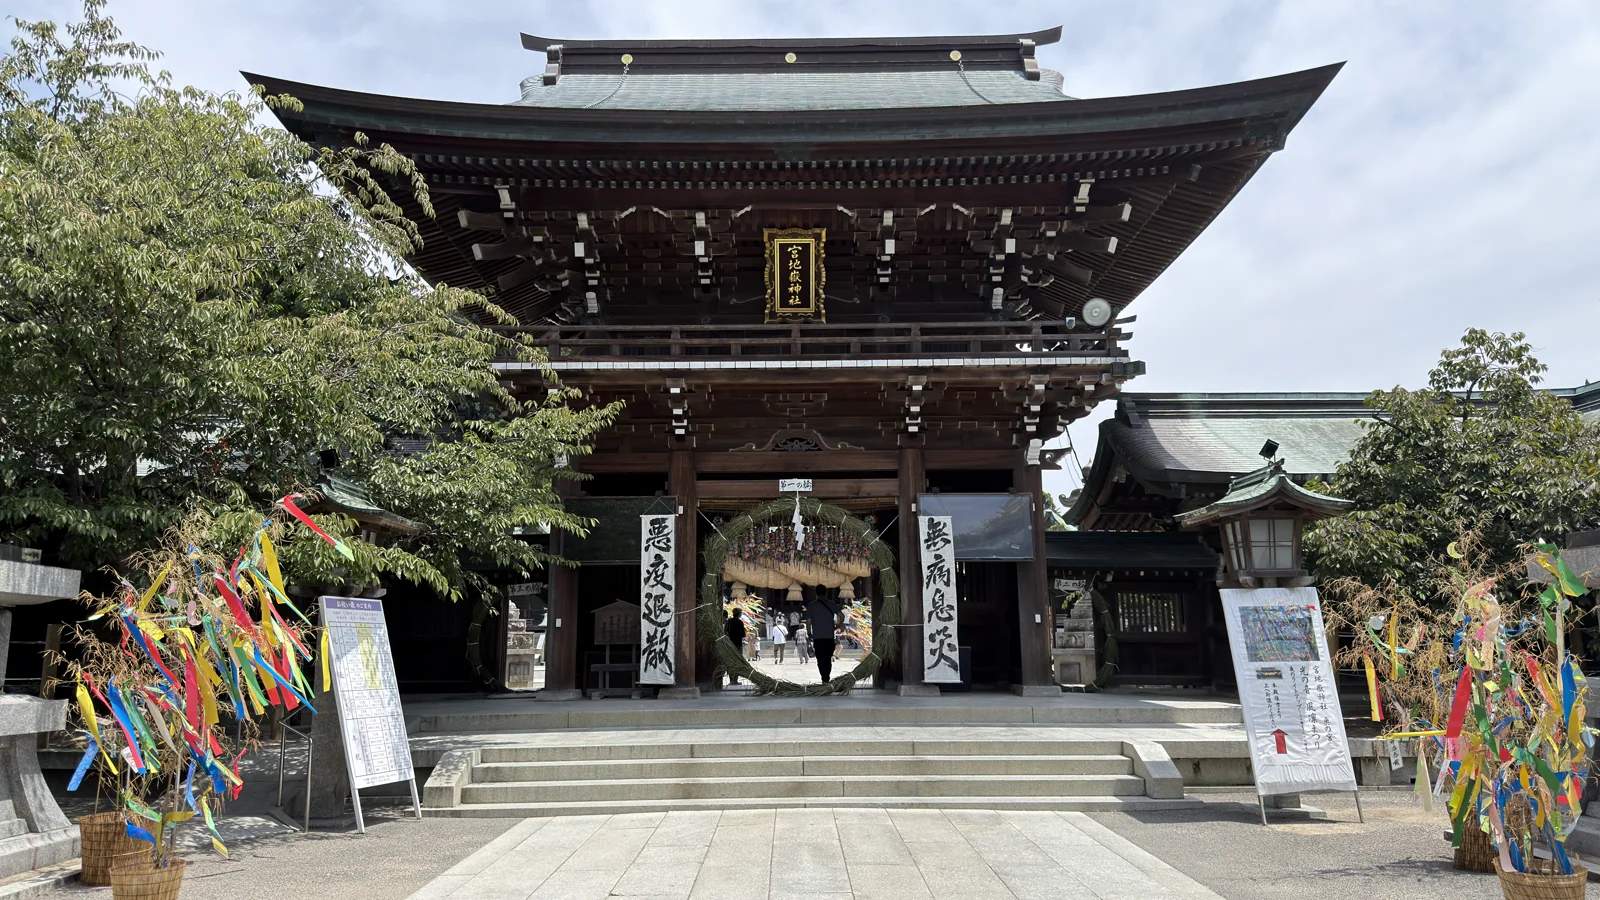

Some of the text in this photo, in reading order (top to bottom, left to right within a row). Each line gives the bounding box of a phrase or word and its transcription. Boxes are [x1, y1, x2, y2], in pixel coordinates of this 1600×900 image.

[787, 245, 803, 306] 宮地嶽神社
[642, 517, 673, 676] 悪疫退散
[923, 517, 959, 673] 無病息災
[1300, 666, 1311, 694] 光の音
[1313, 665, 1328, 711] 宮地嶽神社
